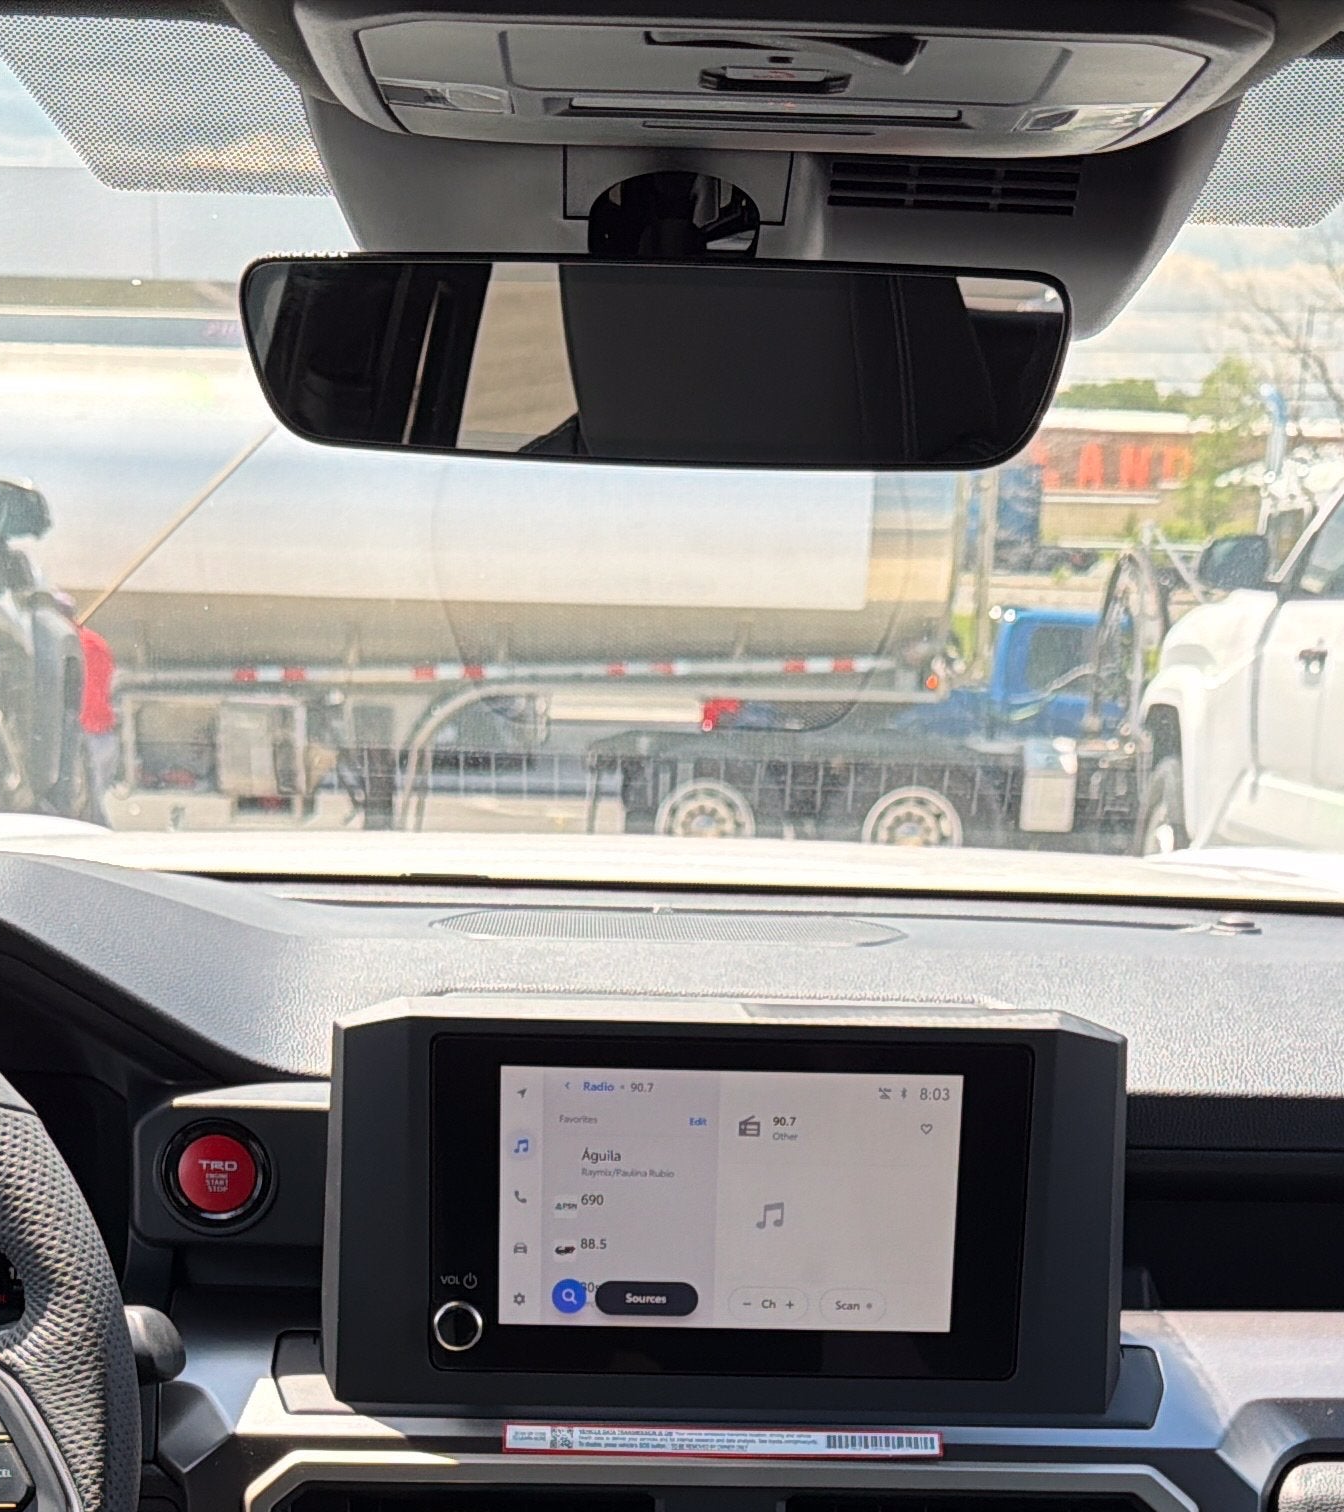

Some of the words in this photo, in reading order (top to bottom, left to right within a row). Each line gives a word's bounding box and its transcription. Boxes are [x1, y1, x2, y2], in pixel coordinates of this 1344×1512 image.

[583, 1082, 614, 1092] Radio
[631, 1082, 654, 1092] 90.7
[919, 1087, 950, 1101] 8:03
[559, 1114, 598, 1125] Favorites
[689, 1117, 707, 1126] Edit
[772, 1116, 797, 1127] 90.7
[772, 1131, 798, 1141] Other
[581, 1148, 622, 1164] Águila
[198, 1160, 238, 1172] TRD
[649, 1169, 675, 1178] Rubio
[581, 1194, 604, 1206] 690
[580, 1238, 607, 1250] 88.5
[440, 1275, 460, 1286] VOL
[625, 1293, 667, 1304] Sources
[761, 1299, 776, 1309] Ch
[835, 1301, 860, 1311] Scan
